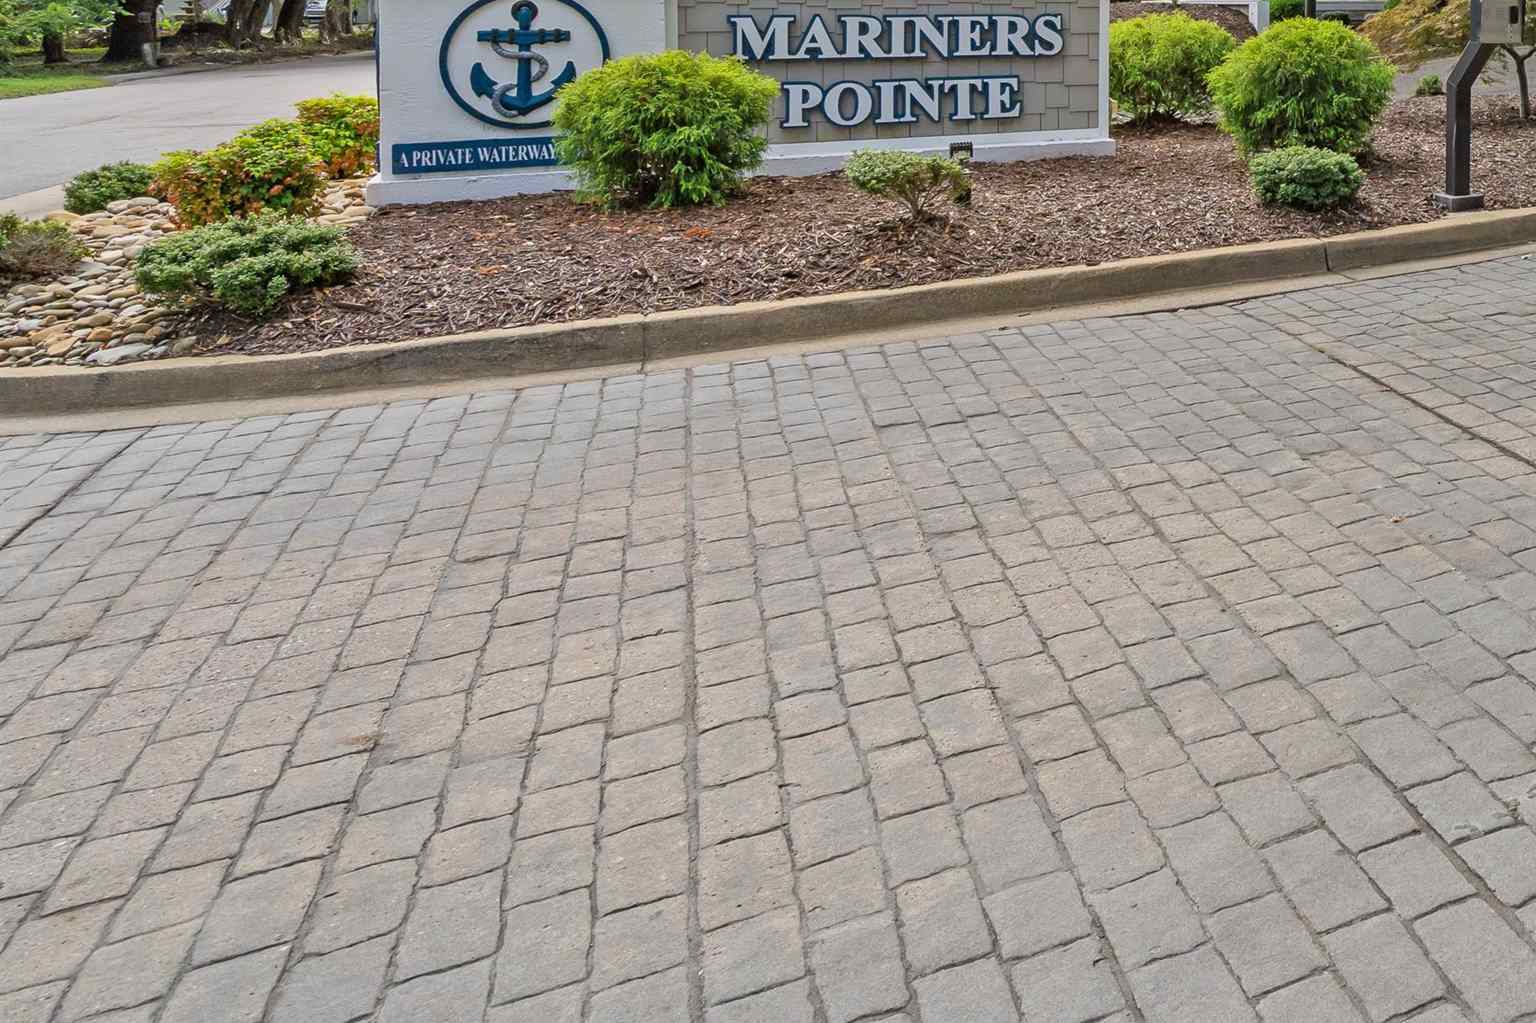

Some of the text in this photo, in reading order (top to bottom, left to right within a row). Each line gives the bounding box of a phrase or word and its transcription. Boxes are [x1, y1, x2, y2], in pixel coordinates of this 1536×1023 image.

[729, 13, 1064, 61] MARINERS
[781, 76, 1022, 128] POINTE
[400, 143, 557, 168] A PRIVATE WATERWAY
